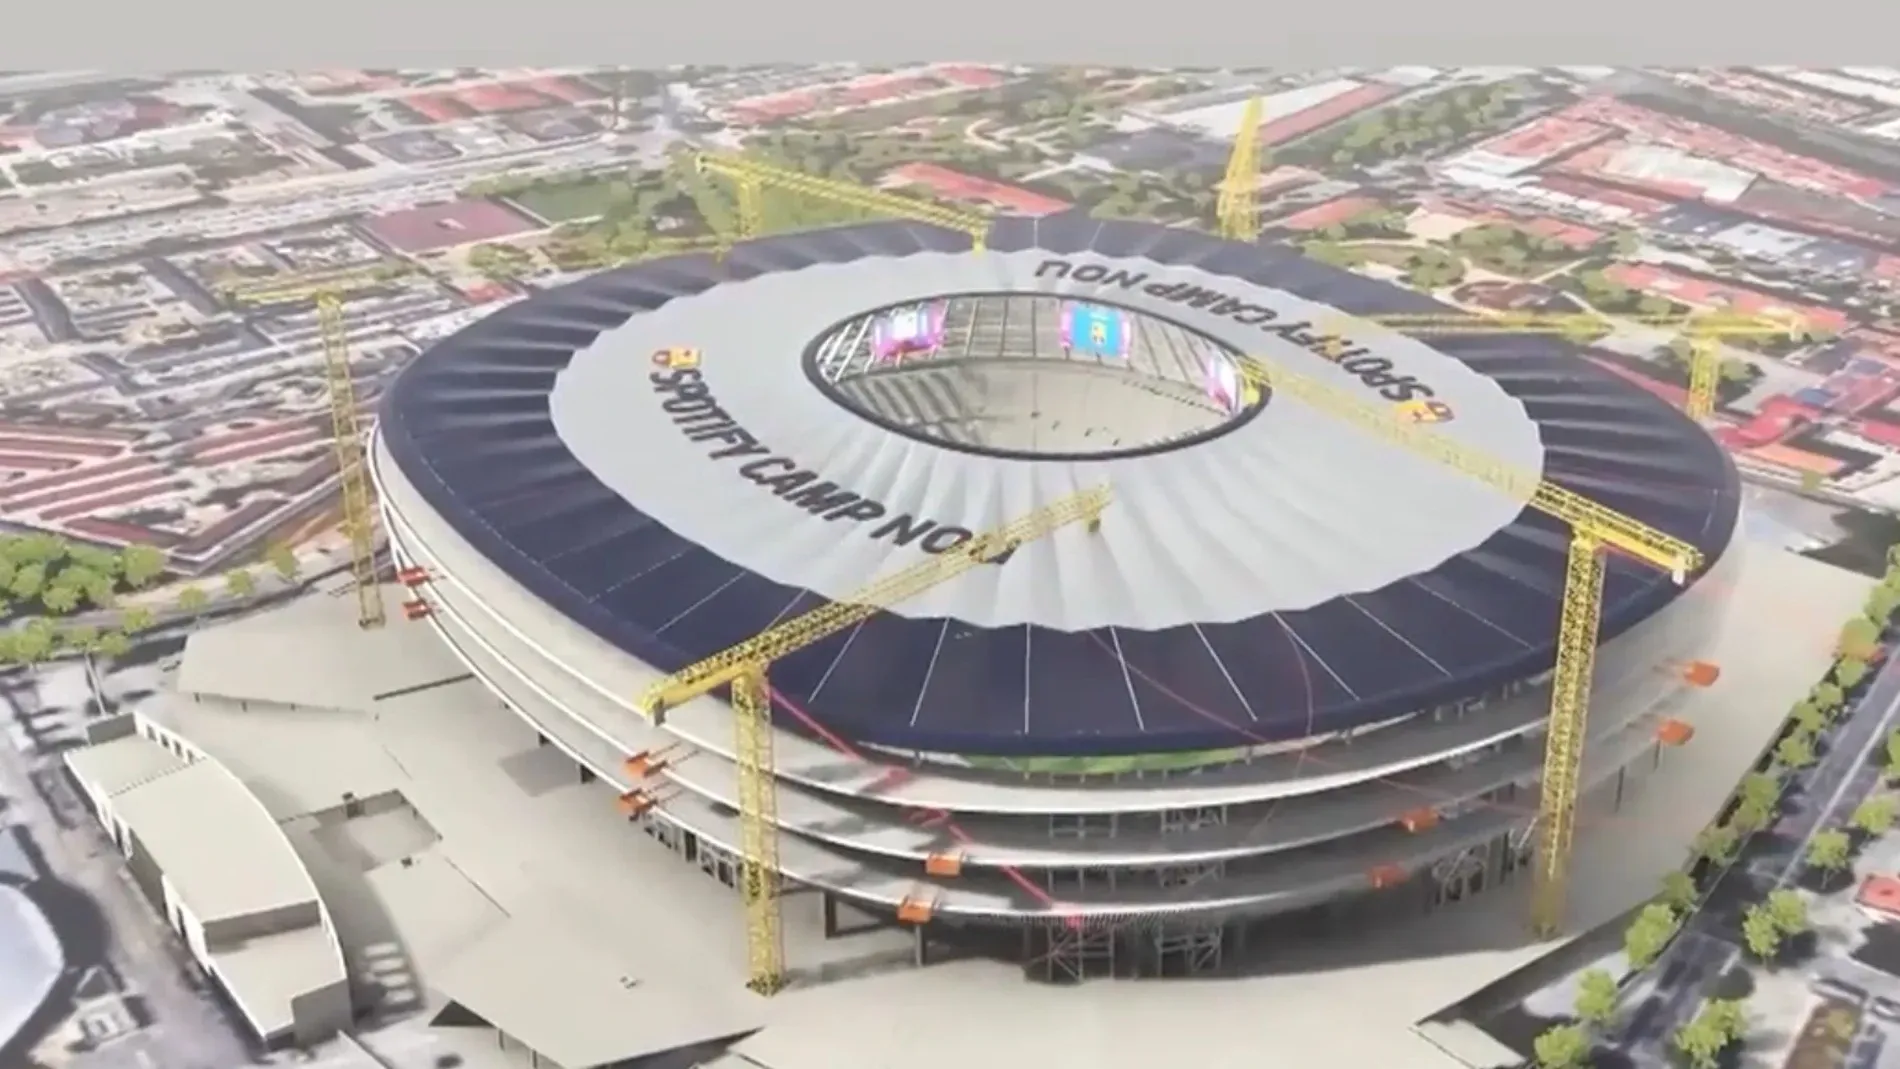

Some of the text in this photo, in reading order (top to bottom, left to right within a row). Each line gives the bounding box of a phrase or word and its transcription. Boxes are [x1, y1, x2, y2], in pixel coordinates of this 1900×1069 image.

[1034, 259, 1149, 289] NOU
[1143, 282, 1278, 325] CAMP
[650, 368, 771, 460] SPOTIFY
[739, 456, 886, 522] CAMP
